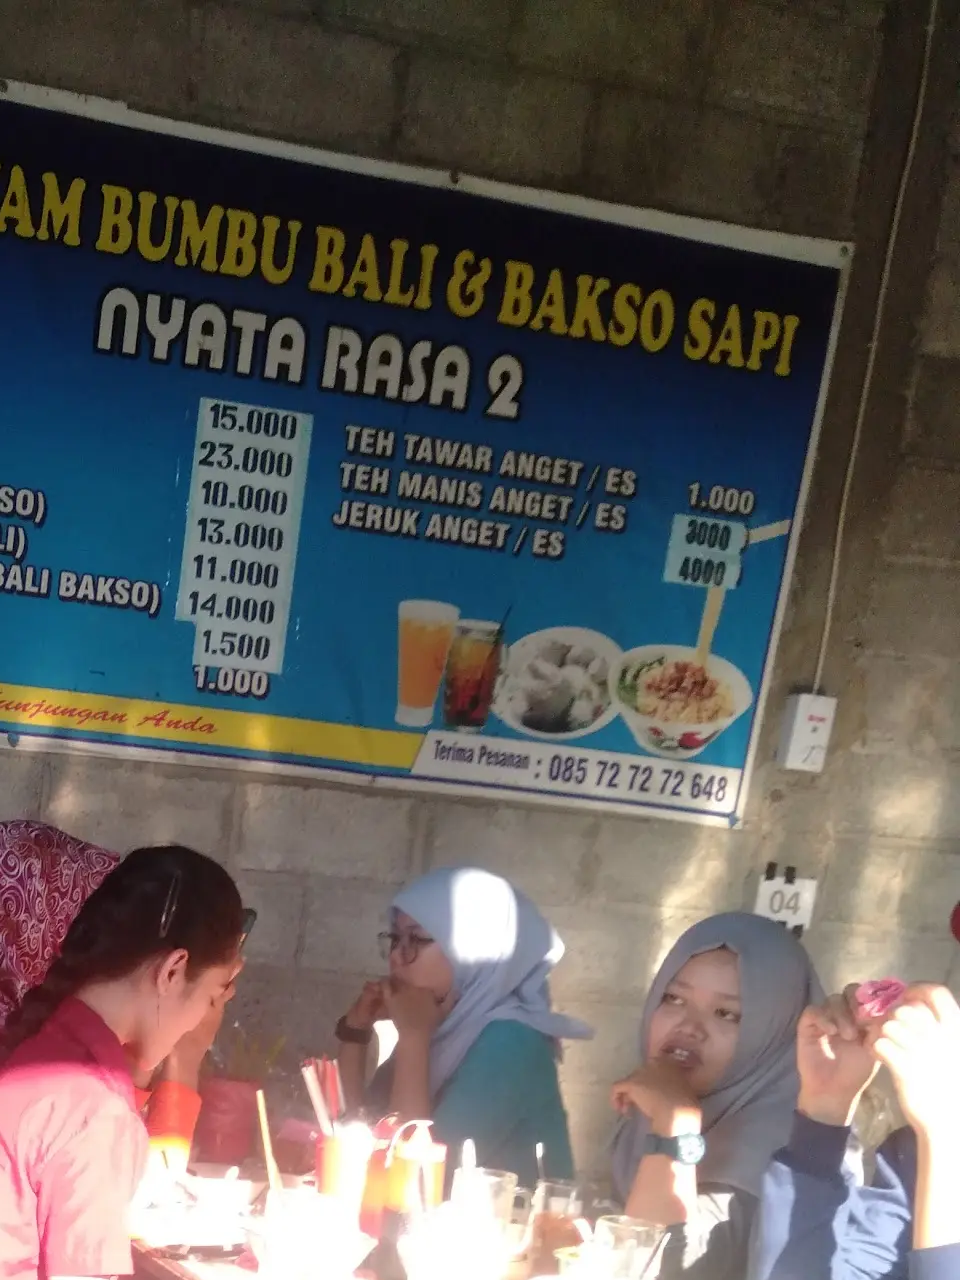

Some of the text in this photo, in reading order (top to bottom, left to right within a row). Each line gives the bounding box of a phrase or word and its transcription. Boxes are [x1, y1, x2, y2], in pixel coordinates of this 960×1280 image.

[95, 184, 302, 284] BUMBU
[308, 225, 440, 311] BALI
[445, 250, 495, 317] &
[498, 259, 675, 354] BAKSO
[683, 297, 802, 376] SAPI
[96, 287, 525, 420] NYATA RASA 2
[210, 403, 297, 440] 15.000
[198, 441, 293, 478] 23.000
[345, 425, 394, 457] TEH
[404, 433, 493, 472] TAWAR
[499, 451, 585, 486] ANGET
[605, 467, 637, 496] ES
[201, 480, 288, 516] 10.000
[340, 462, 390, 494] TEH
[397, 470, 483, 508] MANIS
[489, 486, 574, 522] ANGET
[595, 502, 628, 531] ES
[688, 481, 755, 515] 1.000
[197, 517, 284, 552] 13.000
[332, 500, 421, 536] JERUK
[424, 513, 511, 549] ANGET
[532, 529, 565, 557] ES
[193, 554, 279, 589] 11.000
[58, 571, 161, 615] BAKSO)
[189, 591, 275, 625] 14.000
[203, 629, 270, 661] 1.500
[194, 665, 269, 696] 1.000
[137, 708, 218, 735] Anda
[434, 739, 474, 763] Terima
[477, 744, 530, 770] Pesanan
[548, 755, 589, 785] 085
[596, 758, 622, 788] 72
[628, 763, 652, 793] 72
[659, 768, 684, 797] 72
[691, 772, 730, 802] 648
[768, 889, 803, 917] 04
